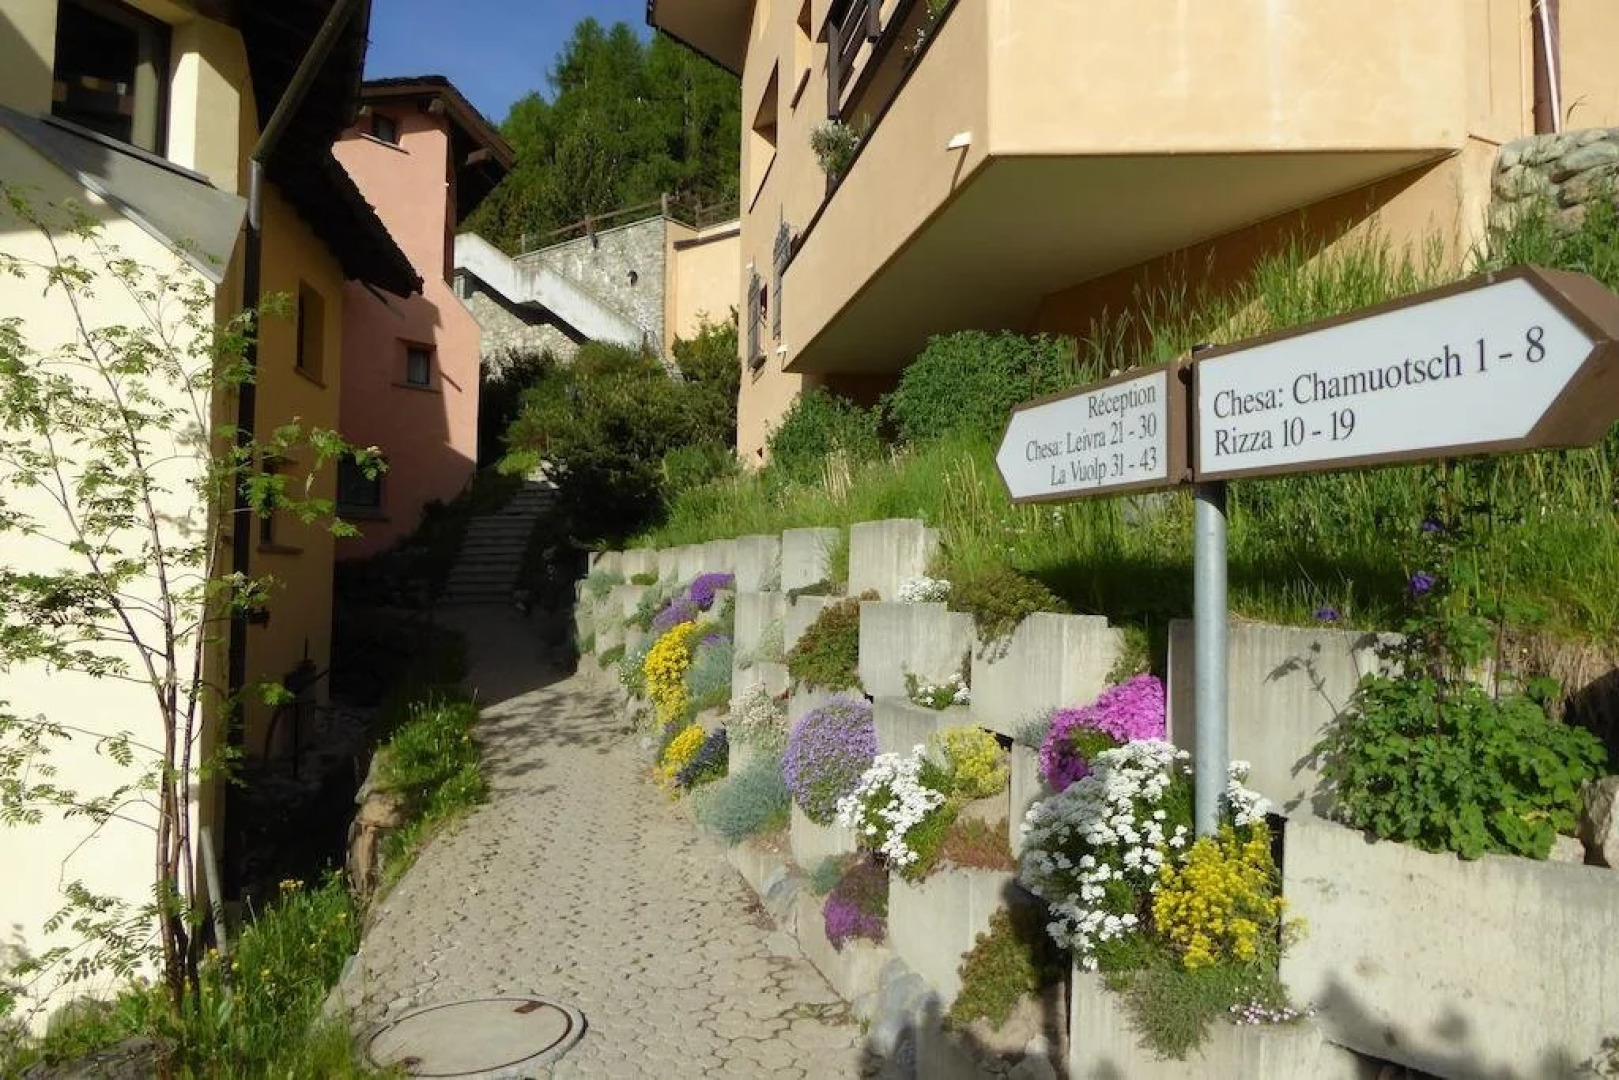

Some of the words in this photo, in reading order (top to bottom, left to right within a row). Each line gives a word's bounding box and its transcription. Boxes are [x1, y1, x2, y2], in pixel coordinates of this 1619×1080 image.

[1213, 388, 1283, 419] Chesa:
[1292, 344, 1462, 404] Chamuotsch
[1476, 337, 1487, 372] 1
[1526, 325, 1545, 363] 8
[1088, 384, 1156, 418] Réception
[1026, 439, 1062, 462] Chesa:
[1066, 428, 1106, 454] Leivra
[1110, 421, 1123, 445] 21
[1139, 413, 1157, 439] 30
[1215, 427, 1273, 456] Rizza
[1282, 417, 1304, 447] 10
[1331, 408, 1355, 441] 19
[1051, 465, 1066, 486] La
[1070, 456, 1107, 485] Vuolp
[1110, 453, 1124, 477] 31
[1139, 446, 1157, 471] 43
